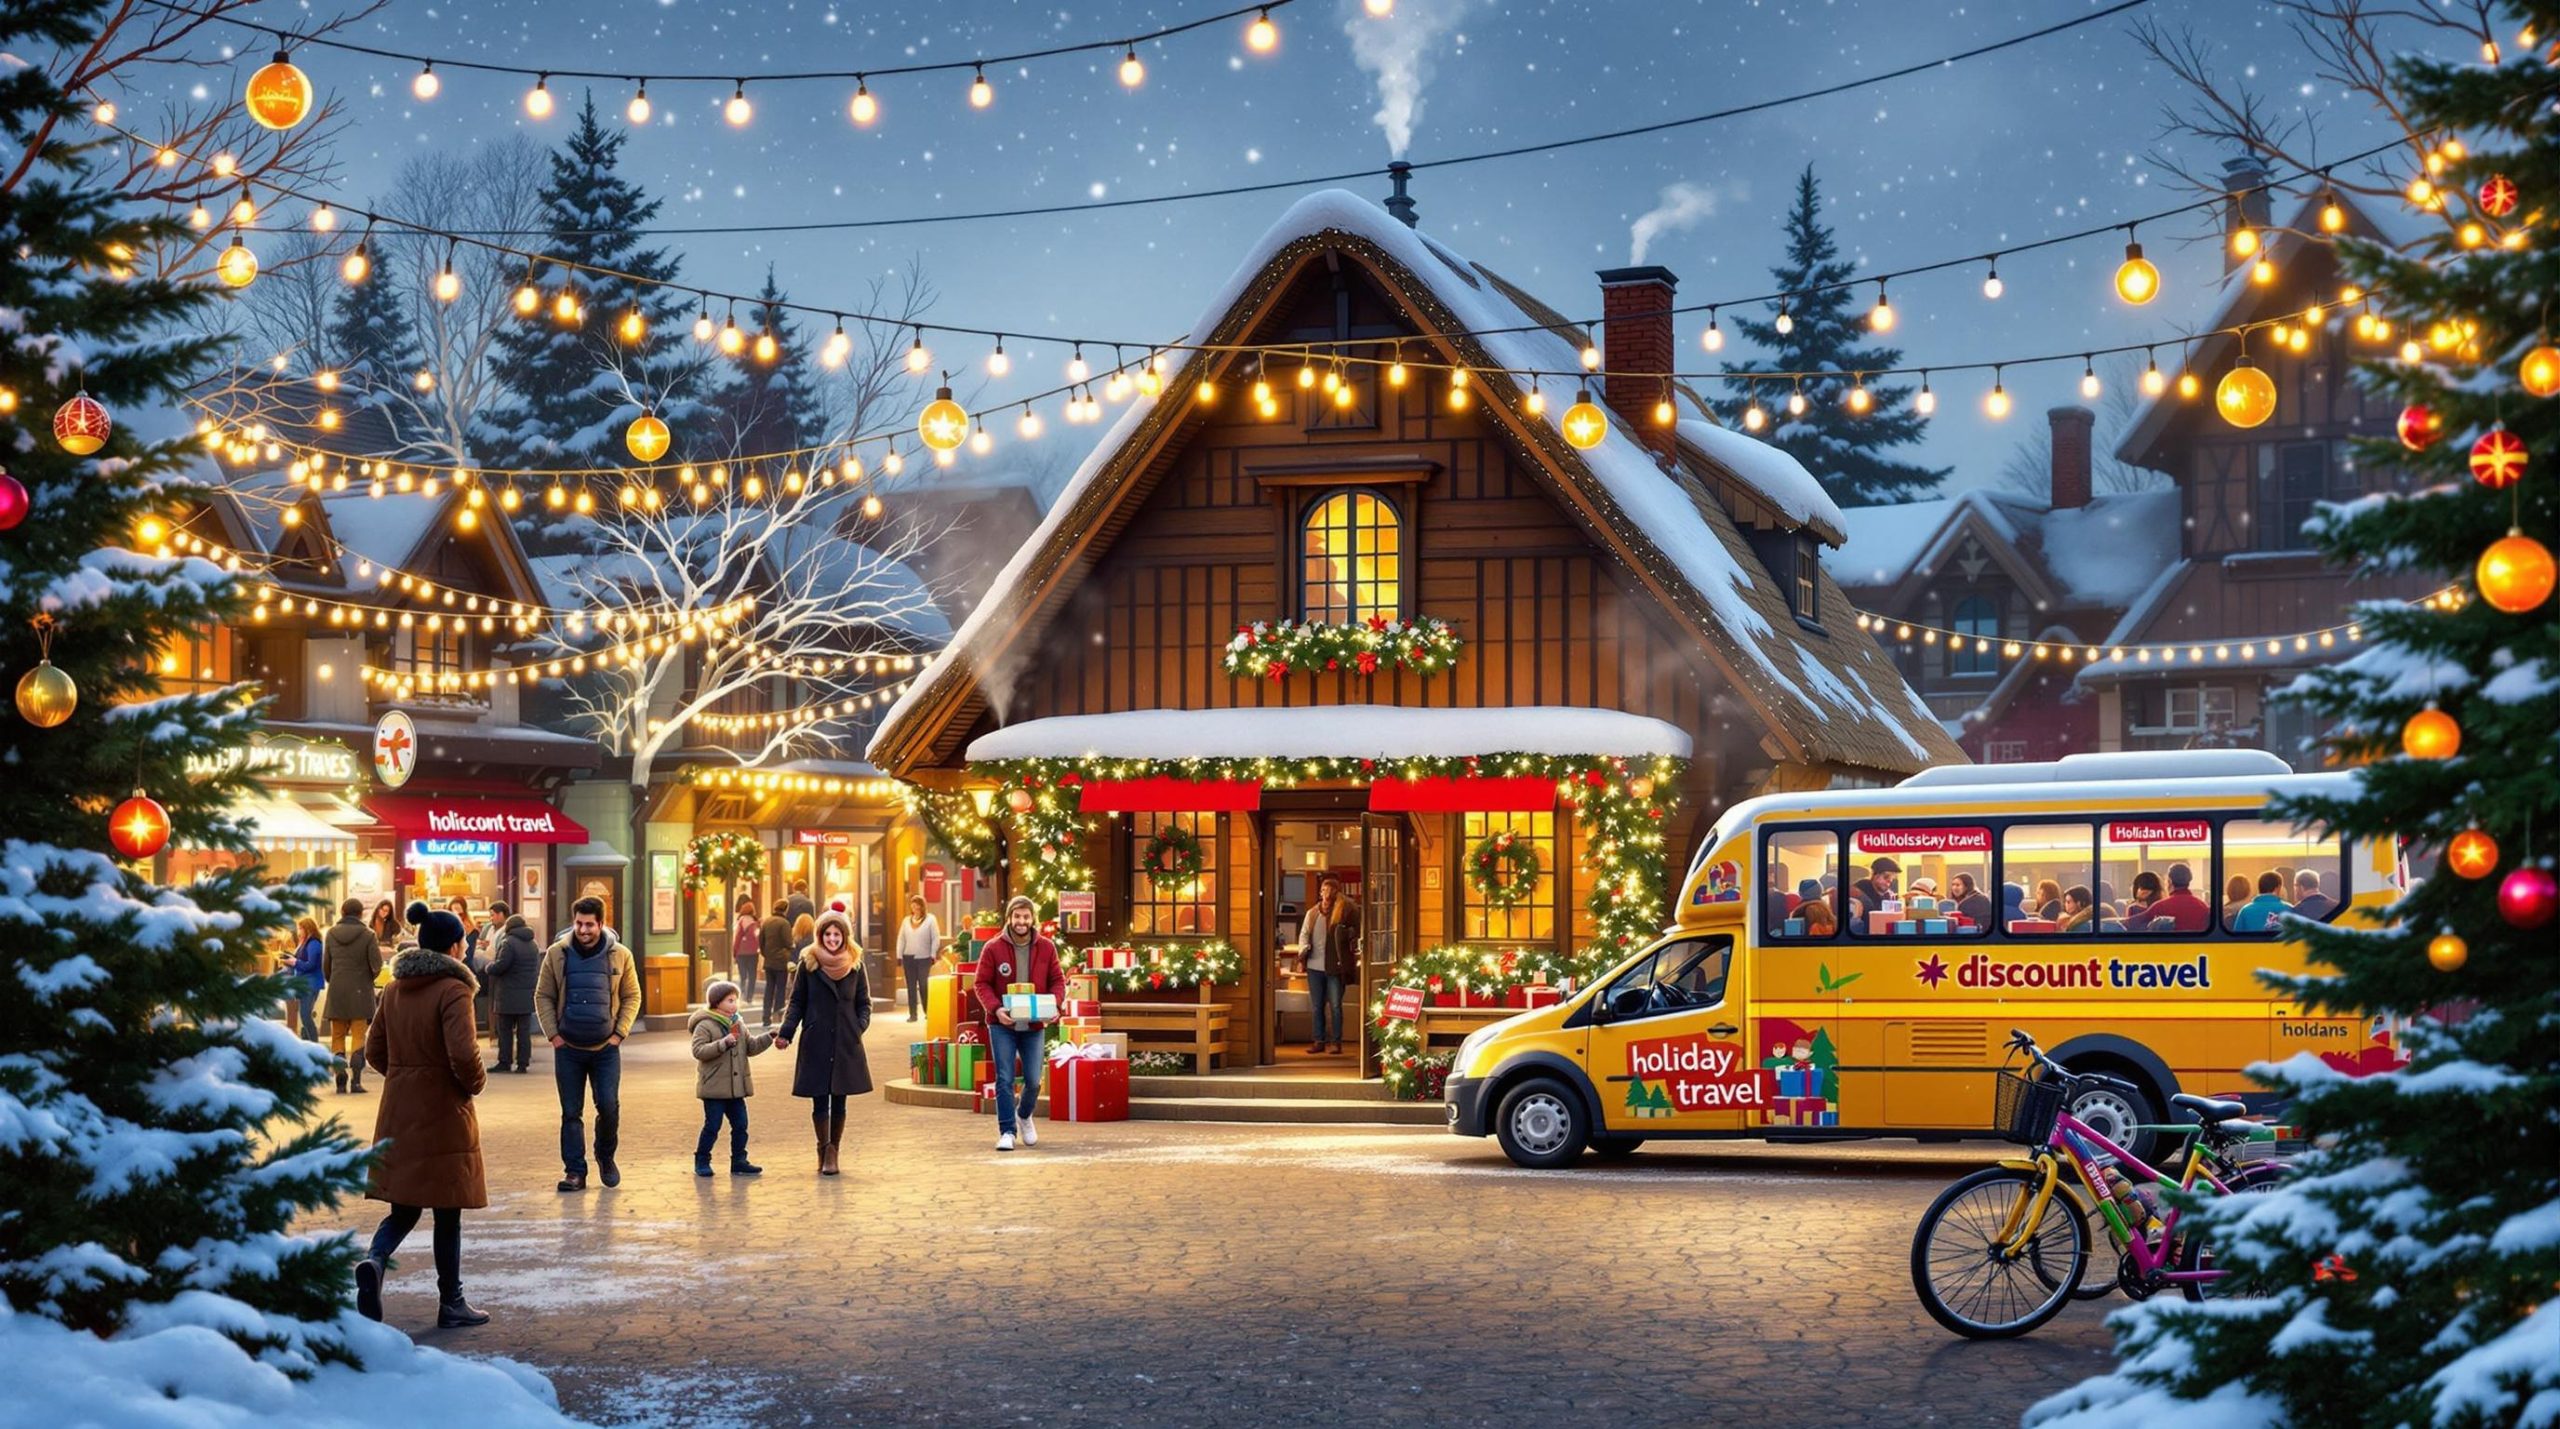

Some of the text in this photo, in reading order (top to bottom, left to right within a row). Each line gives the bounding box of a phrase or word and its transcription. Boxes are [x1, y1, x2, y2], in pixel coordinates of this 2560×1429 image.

[507, 812, 555, 832] travel
[2166, 824, 2202, 838] travel
[1948, 832, 1986, 846] travel
[1956, 954, 2210, 988] discount travel
[2282, 1022, 2348, 1037] holdans
[1631, 1042, 1734, 1078] holiday
[1676, 1073, 1764, 1106] travel
